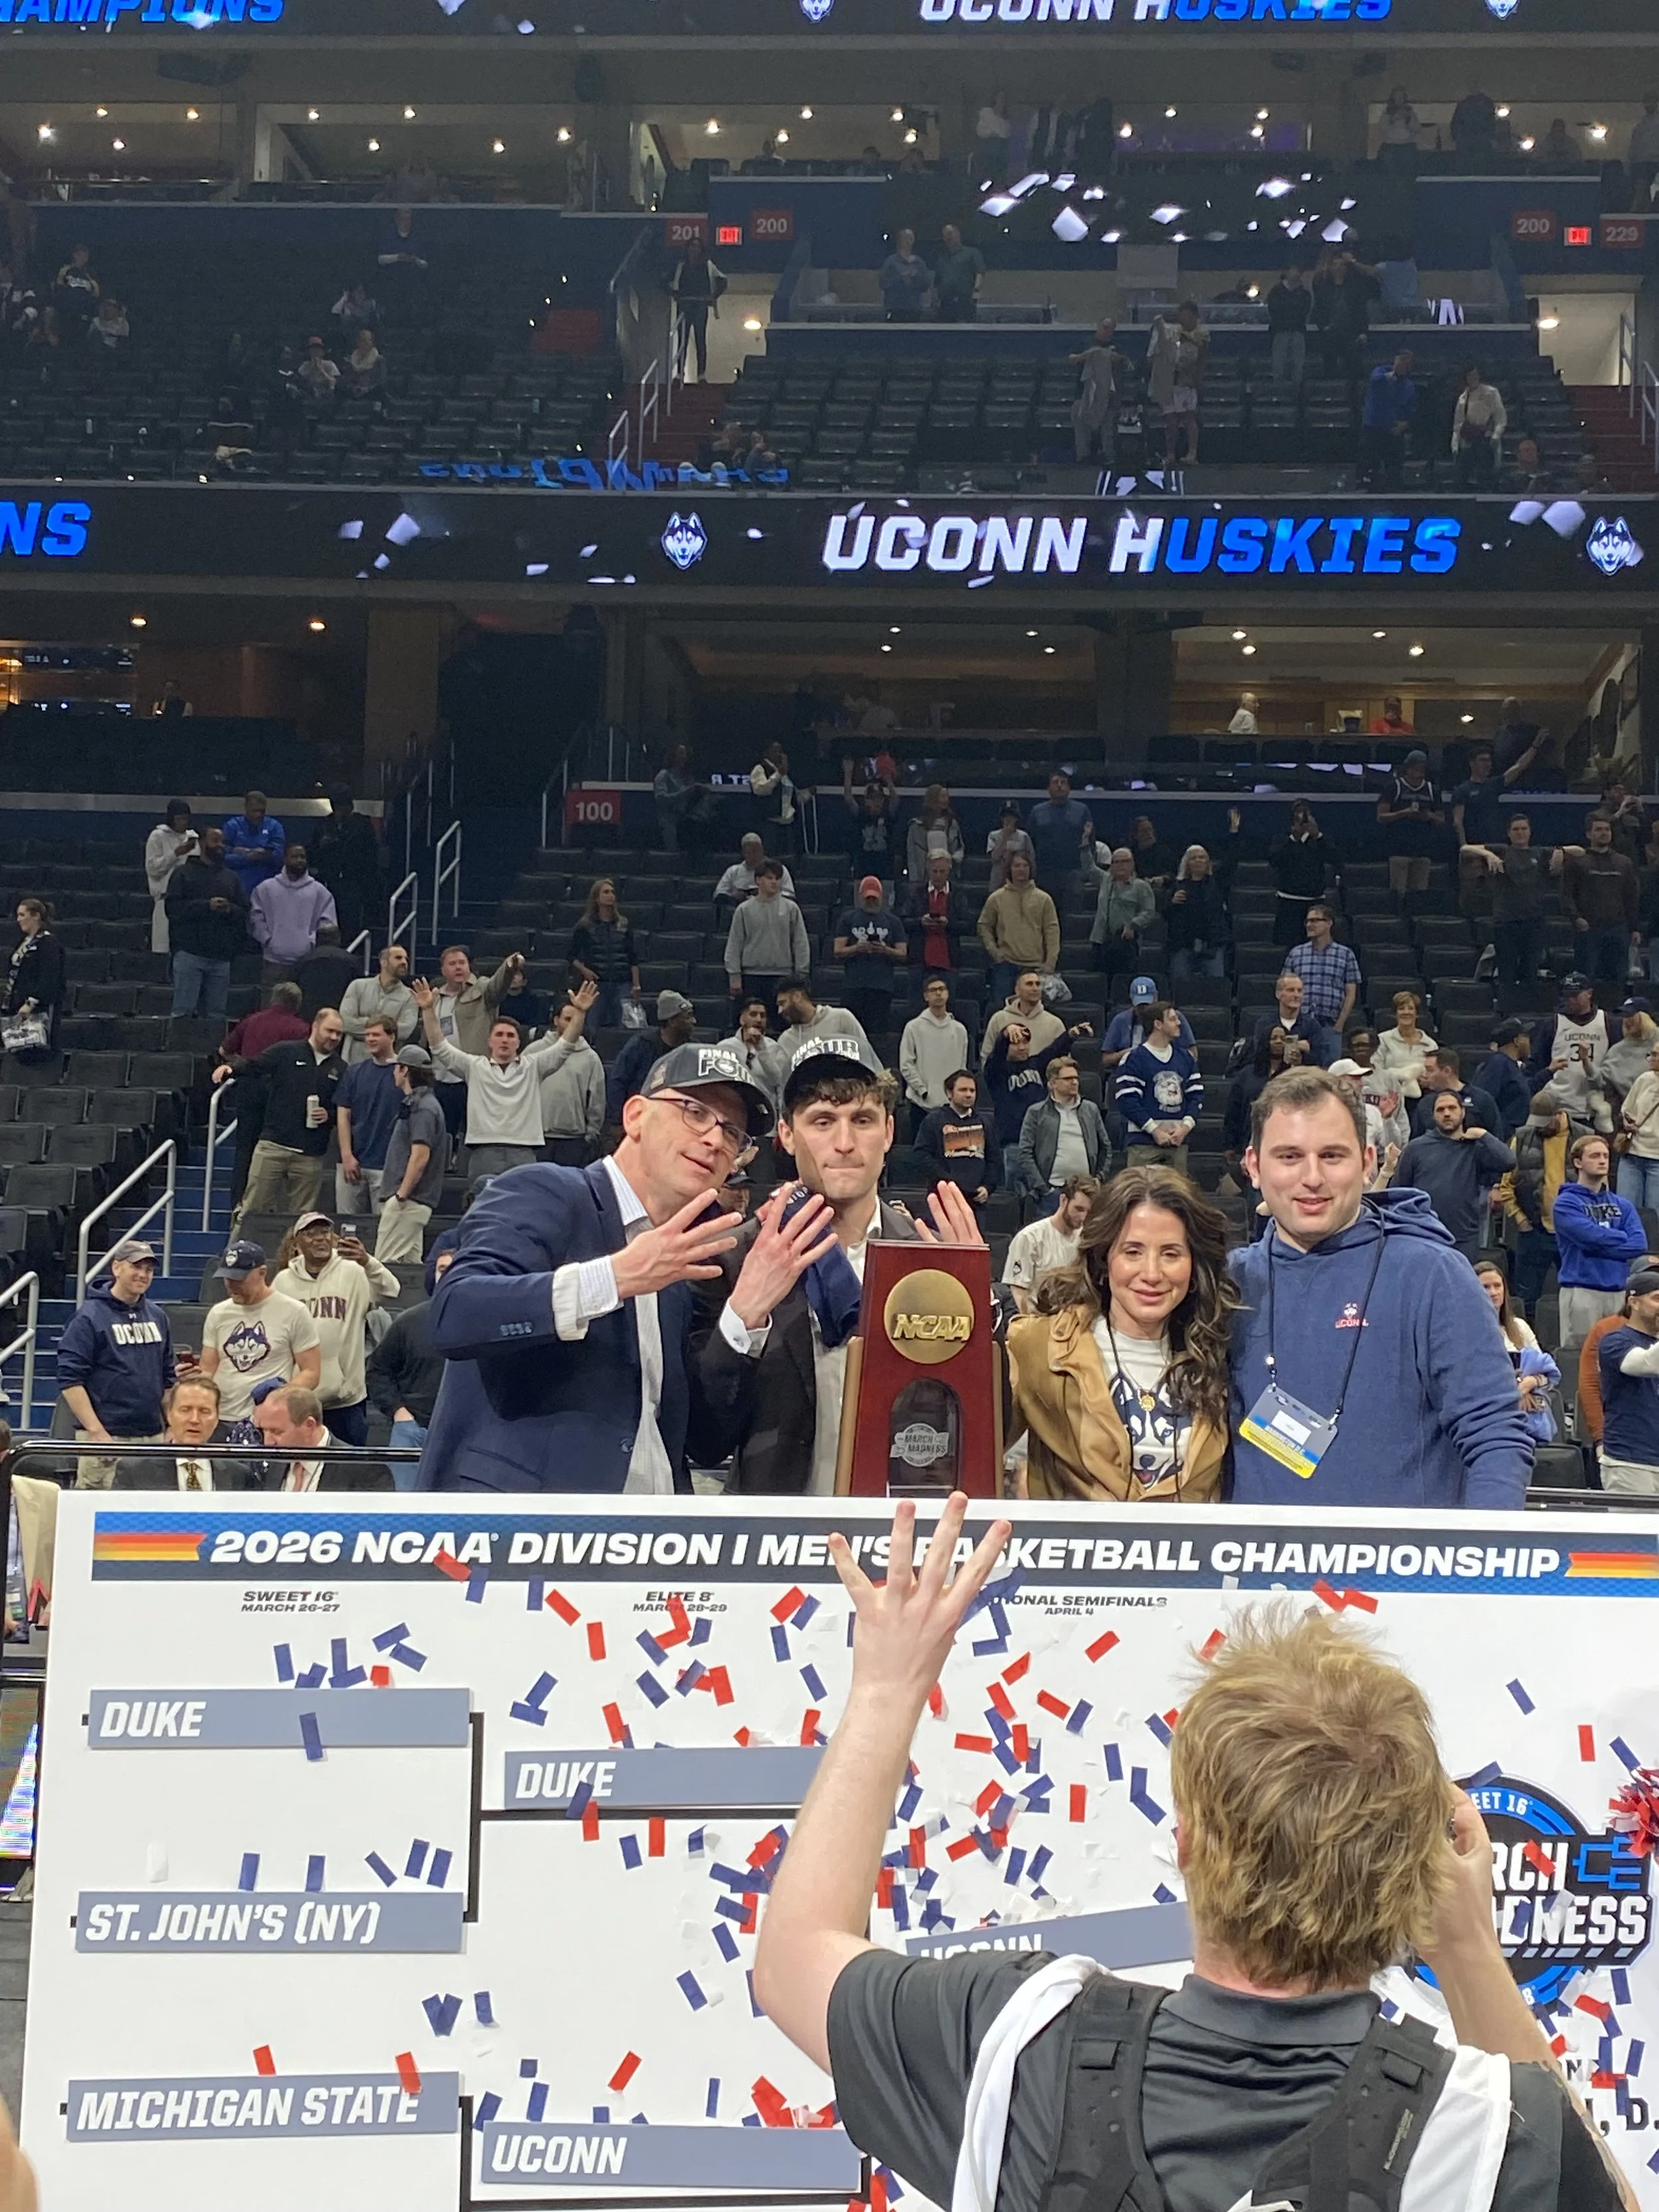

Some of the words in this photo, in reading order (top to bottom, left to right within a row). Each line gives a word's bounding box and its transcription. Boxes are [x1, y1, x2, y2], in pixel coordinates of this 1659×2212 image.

[672, 226, 700, 240] 201
[757, 218, 787, 233] 200
[1517, 218, 1550, 234] 200
[1606, 226, 1638, 242] 229
[822, 515, 1087, 573] UCONN
[1110, 517, 1461, 573] HUSKIES
[575, 801, 613, 821] 100
[299, 1296, 346, 1322] ONN
[111, 1321, 163, 1345] UCONN
[892, 1313, 971, 1343] NCAA
[210, 1530, 344, 1564] 2026
[508, 1532, 723, 1565] DIVISION
[731, 1534, 749, 1566] I
[757, 1534, 891, 1567] ME'S
[1211, 1541, 1559, 1578] CHAMPIONSHIP
[243, 1591, 311, 1601] SWEET
[100, 1701, 206, 1737] DUKE
[516, 1761, 616, 1799] DUKE
[1490, 1842, 1569, 1891] RCH
[86, 1903, 139, 1942] ST.
[148, 1903, 287, 1942] JOHN'S
[294, 1901, 380, 1945] (NY)
[77, 2087, 294, 2130] MICHIGAN
[301, 2085, 419, 2126] STATE
[492, 2134, 628, 2175] UCONN
